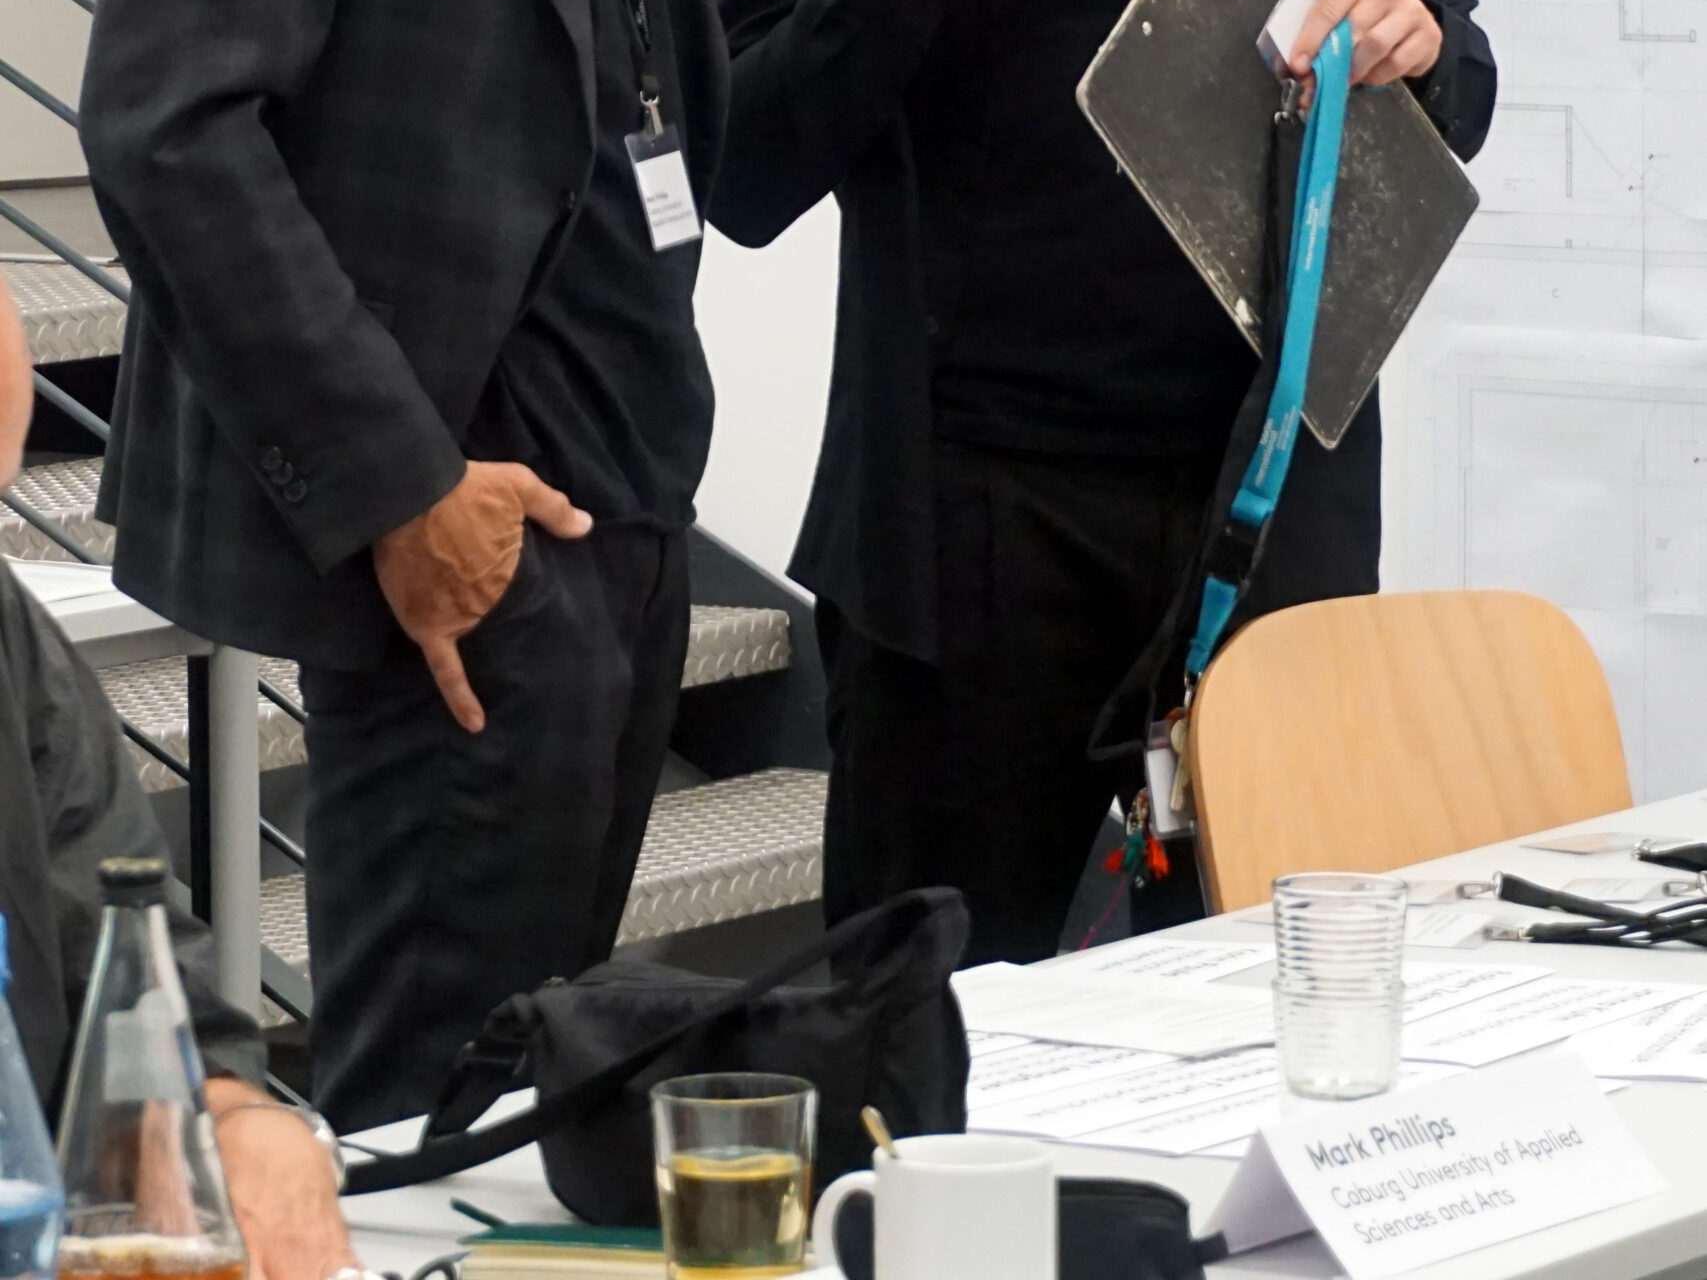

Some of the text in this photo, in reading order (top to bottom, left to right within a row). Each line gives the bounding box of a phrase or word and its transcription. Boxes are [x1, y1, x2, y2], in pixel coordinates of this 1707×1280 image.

[1304, 1113, 1457, 1171] Mark Phillips
[1330, 1123, 1584, 1210] Coburg University of Applied
[1353, 1185, 1517, 1245] Sciences and Arts
